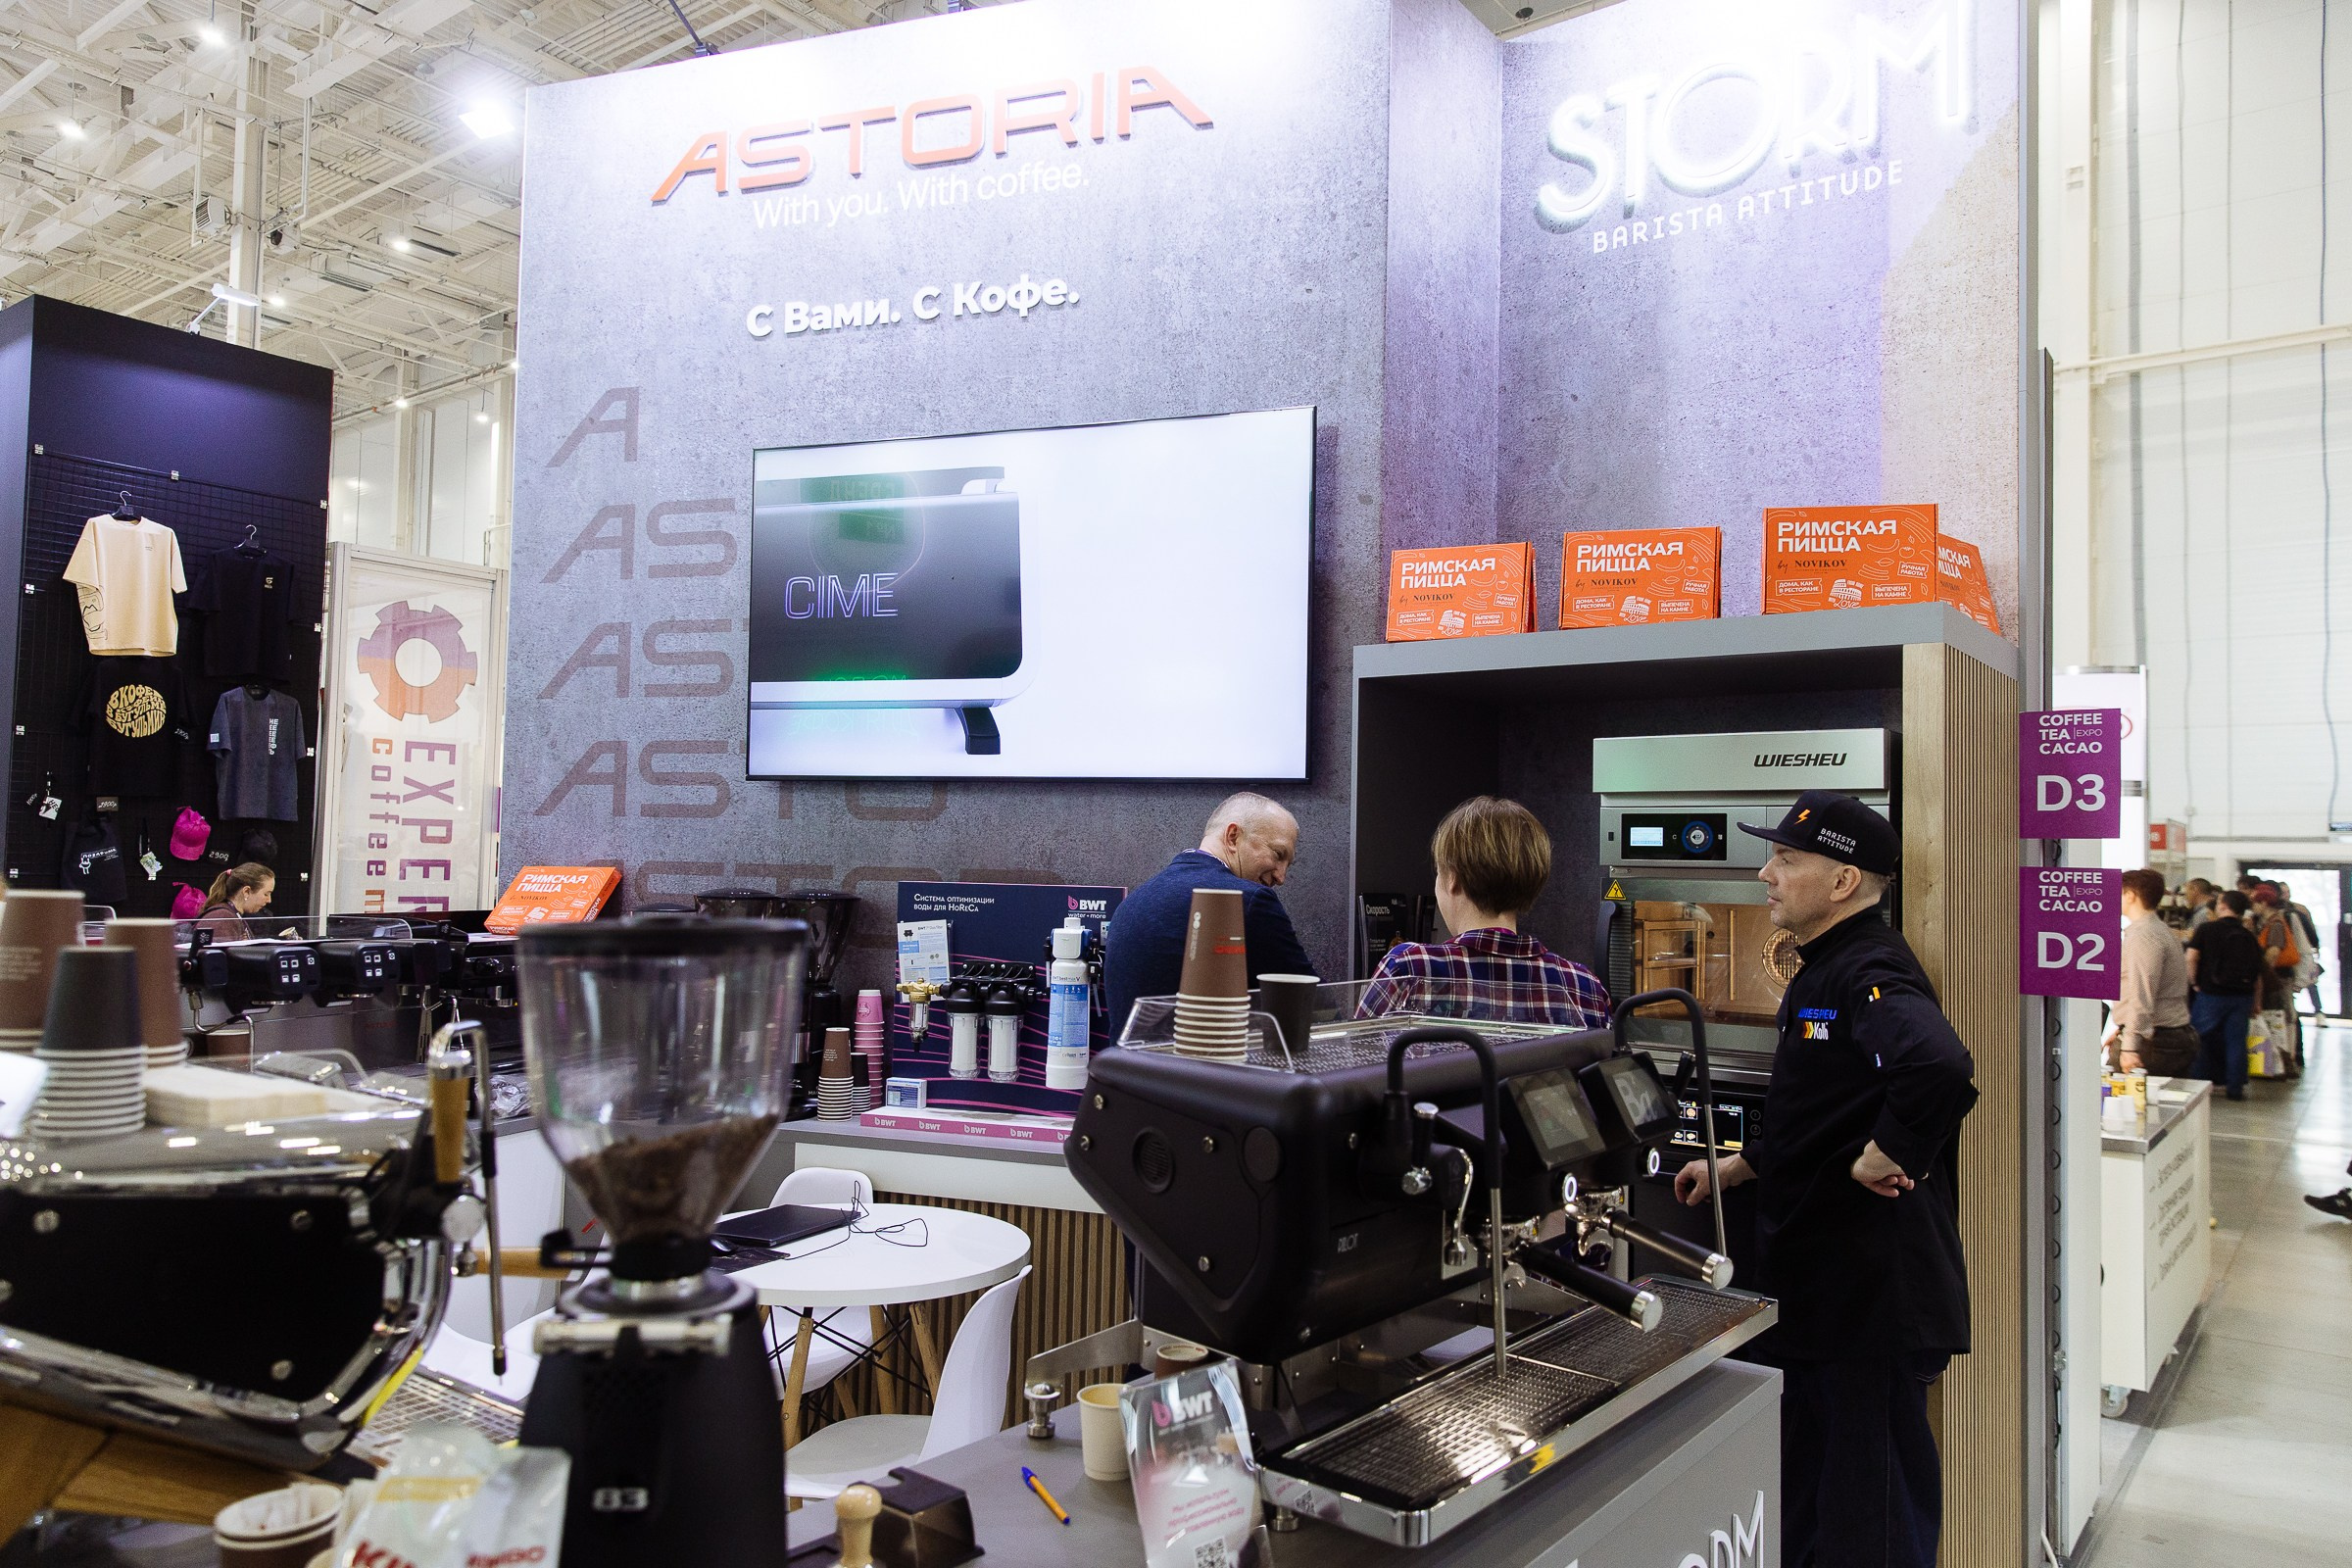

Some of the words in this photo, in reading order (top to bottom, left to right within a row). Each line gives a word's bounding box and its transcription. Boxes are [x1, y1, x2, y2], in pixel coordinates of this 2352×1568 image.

[1537, 0, 1974, 223] STORM
[650, 65, 1215, 202] ASTORIA
[752, 192, 820, 230] With
[826, 188, 889, 228] you.
[897, 169, 971, 213] With
[977, 158, 1091, 202] coffee.
[1592, 203, 1725, 255] BARISTA
[1737, 159, 1904, 221] ATTITUDE
[746, 304, 773, 339] С
[785, 295, 901, 335] Вами.
[912, 287, 942, 322] С
[953, 273, 1082, 318] Кофе.
[545, 387, 639, 467] A
[1778, 519, 1896, 536] РИМСКАЯ
[540, 498, 738, 584] AS
[1778, 537, 1861, 553] ПИЦЦА
[1578, 541, 1684, 559] РИМСКАЯ
[1938, 546, 1972, 568] МСКАЯ
[1401, 558, 1495, 575] РИМСКАЯ
[1577, 558, 1650, 572] ПИЦЦА
[1777, 560, 1788, 573] by
[1794, 560, 1847, 568] NOVIKOV
[1938, 561, 1962, 579] ИЦЦА
[1400, 573, 1467, 589] ПИЦЦА
[1575, 579, 1586, 591] by
[785, 572, 899, 619] CIME
[1399, 595, 1408, 606] by
[1413, 593, 1454, 602] NOVIKOV
[536, 618, 749, 700] AS
[2038, 713, 2102, 726] COFFEE
[2038, 729, 2071, 740] TEA
[2039, 742, 2102, 755] CACAO
[1753, 753, 1847, 767] WIESHEU
[2036, 773, 2106, 811] D3
[367, 738, 400, 876] coffee
[1817, 835, 1854, 855] ATTITUDE
[1821, 828, 1856, 847] BARISTA
[521, 874, 589, 884] РИМСКАЯ
[2038, 871, 2102, 883] COFFEE
[515, 883, 562, 893] ПИЦЦА
[2038, 886, 2070, 897] TEA
[1079, 900, 1106, 910] BWT
[2038, 900, 2103, 912] CACAO
[2037, 932, 2105, 971] D2
[1798, 1007, 1838, 1019] WIESHEU
